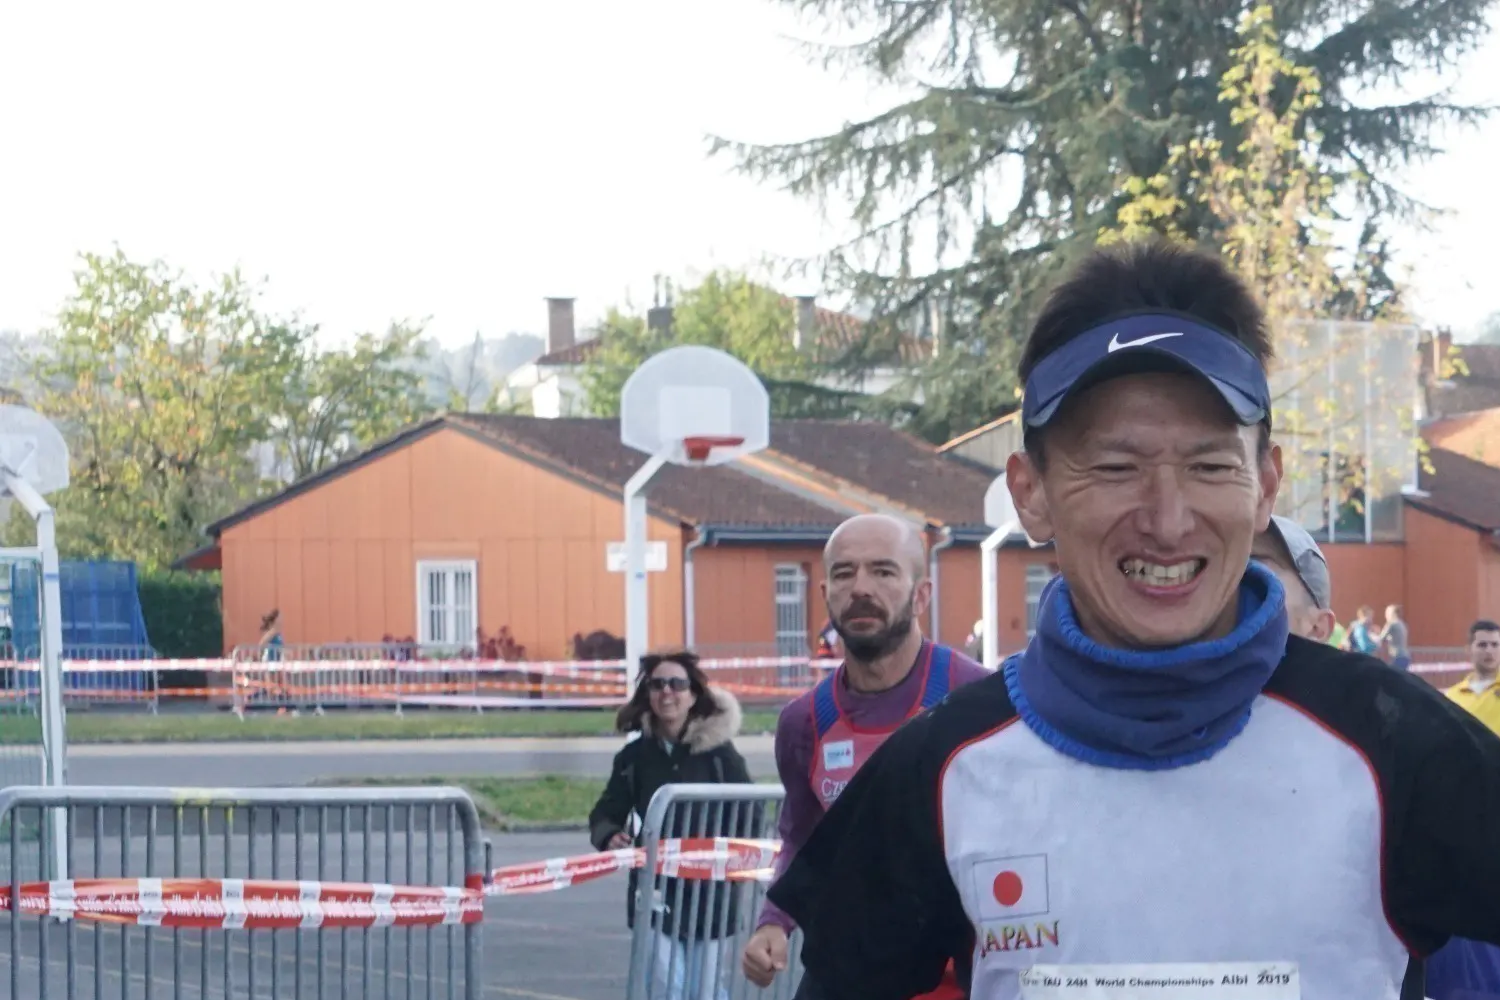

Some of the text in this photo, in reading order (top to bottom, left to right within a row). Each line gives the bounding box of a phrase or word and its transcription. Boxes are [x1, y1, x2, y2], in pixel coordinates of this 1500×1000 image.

[1095, 977, 1126, 987] World
[1129, 976, 1215, 988] Championships
[1221, 974, 1248, 985] Albi
[1256, 973, 1290, 985] 2019
